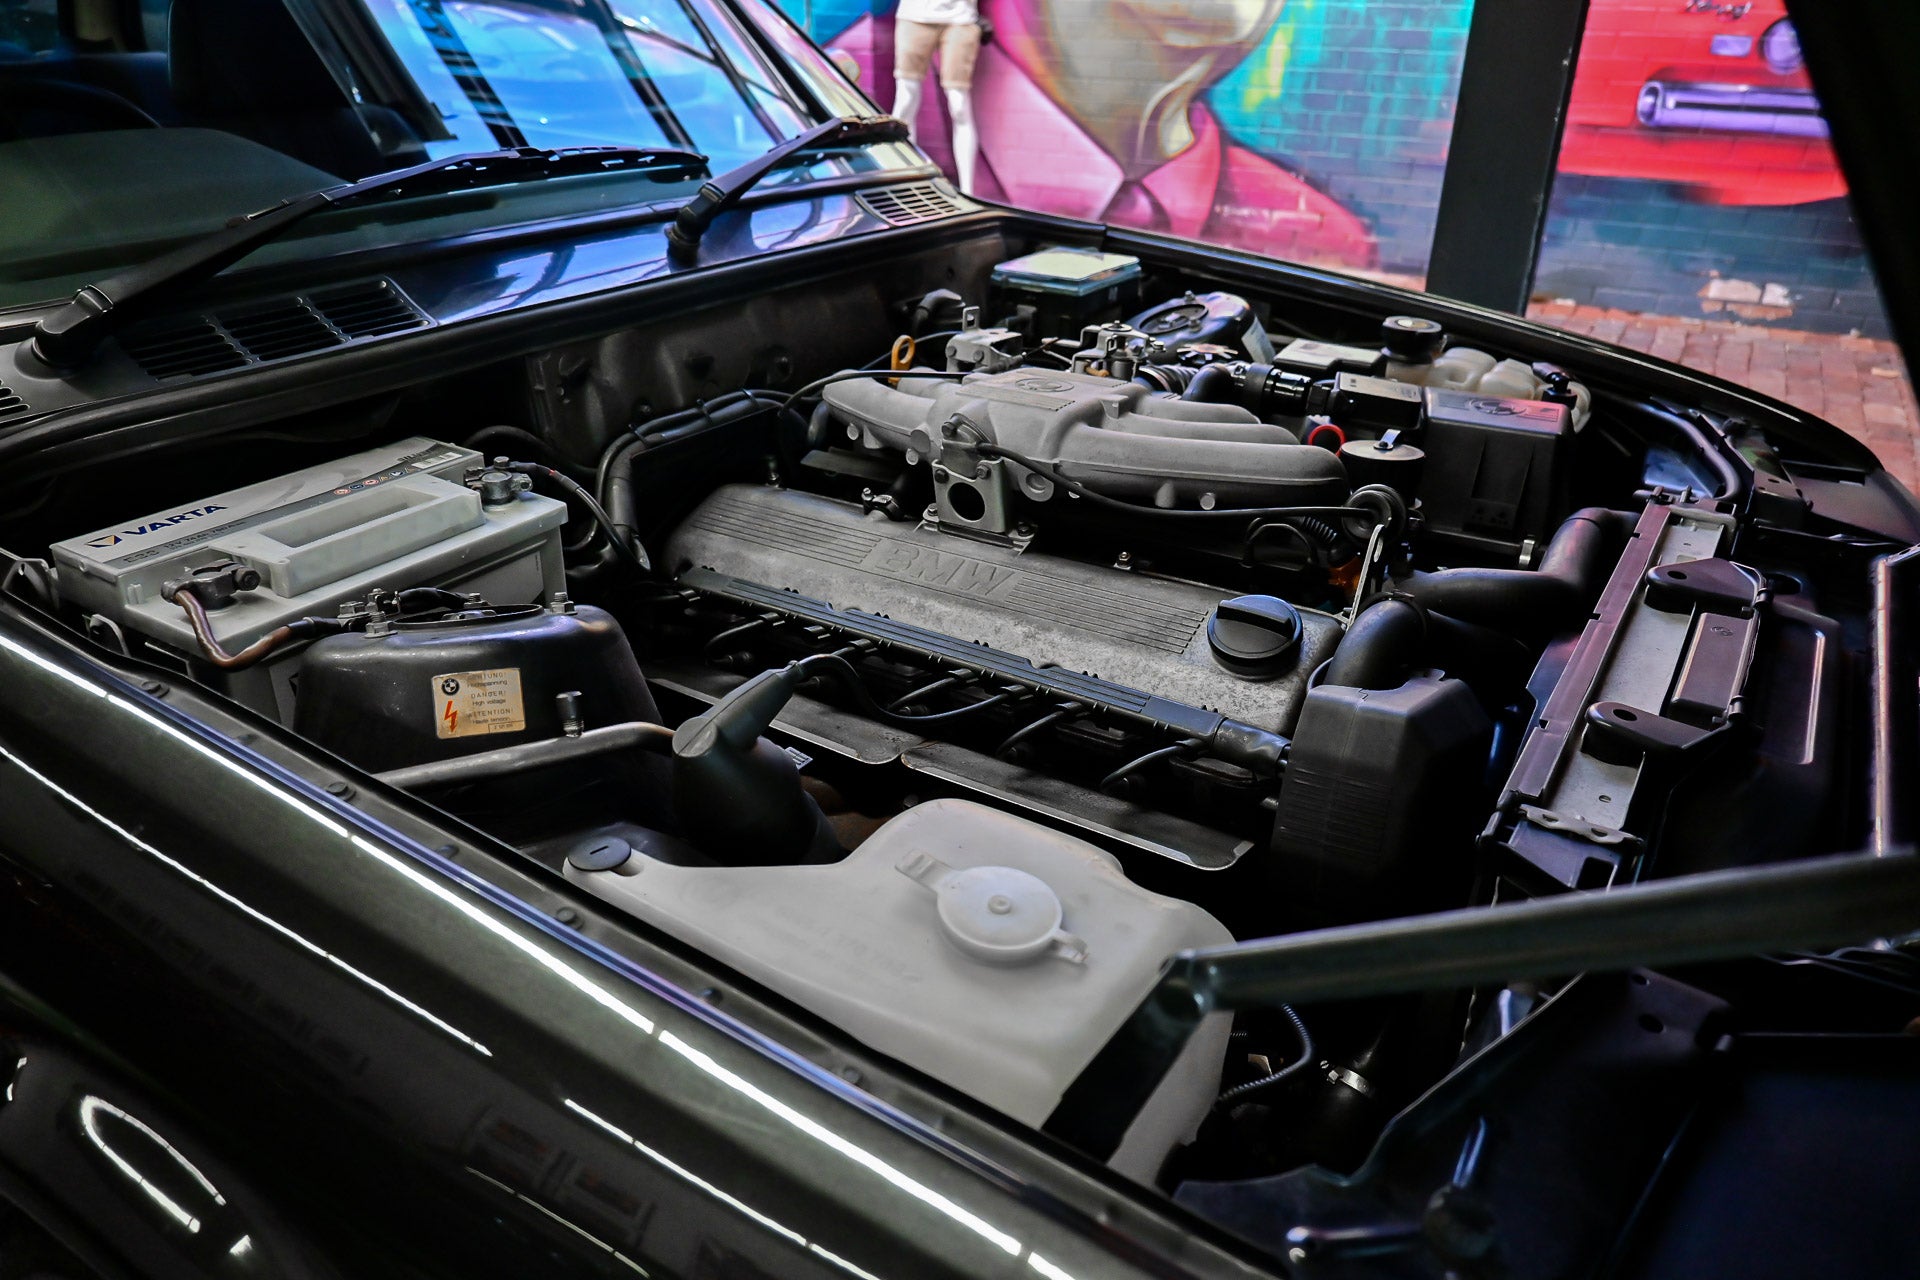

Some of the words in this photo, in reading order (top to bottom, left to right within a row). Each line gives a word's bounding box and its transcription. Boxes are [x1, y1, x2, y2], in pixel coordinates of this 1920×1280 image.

[121, 505, 228, 535] VARTA
[874, 548, 1016, 596] BMW
[471, 690, 506, 699] DANGER!
